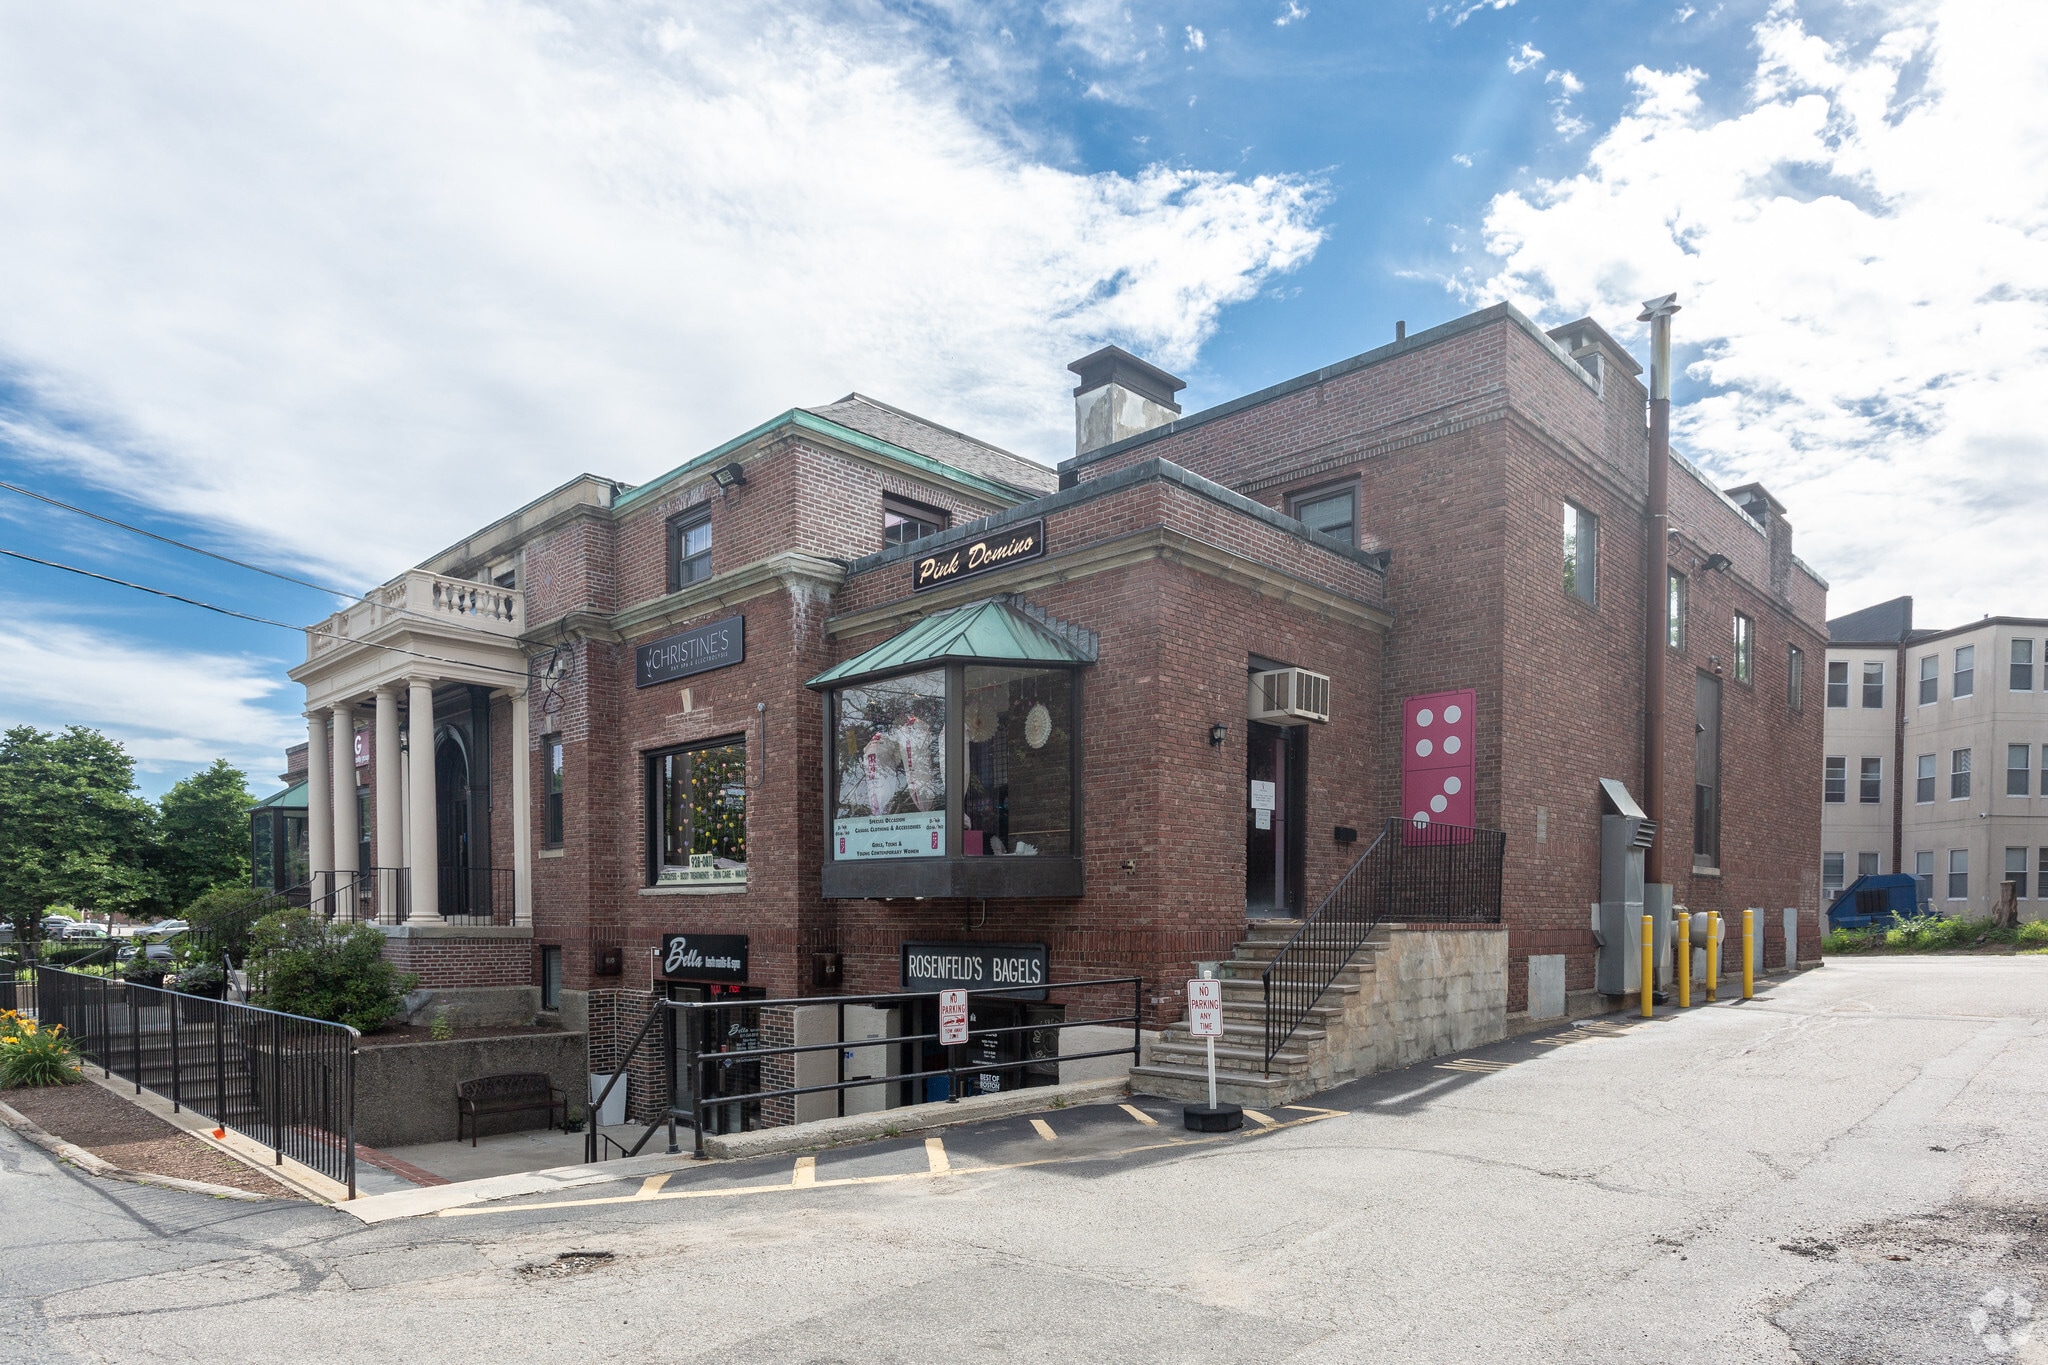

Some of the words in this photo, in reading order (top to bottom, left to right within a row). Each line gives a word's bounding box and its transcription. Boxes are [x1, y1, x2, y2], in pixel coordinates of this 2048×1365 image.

[920, 552, 960, 584] Pink
[968, 536, 1034, 568] Domino
[652, 630, 728, 668] CHRISTINE'S
[665, 937, 703, 972] Bella
[909, 955, 982, 980] ROSENFELD'S
[993, 958, 1040, 984] BAGELS
[950, 994, 957, 1003] NO
[1199, 986, 1209, 996] NO
[942, 1005, 965, 1014] PARKING
[1192, 1000, 1218, 1009] PARKING
